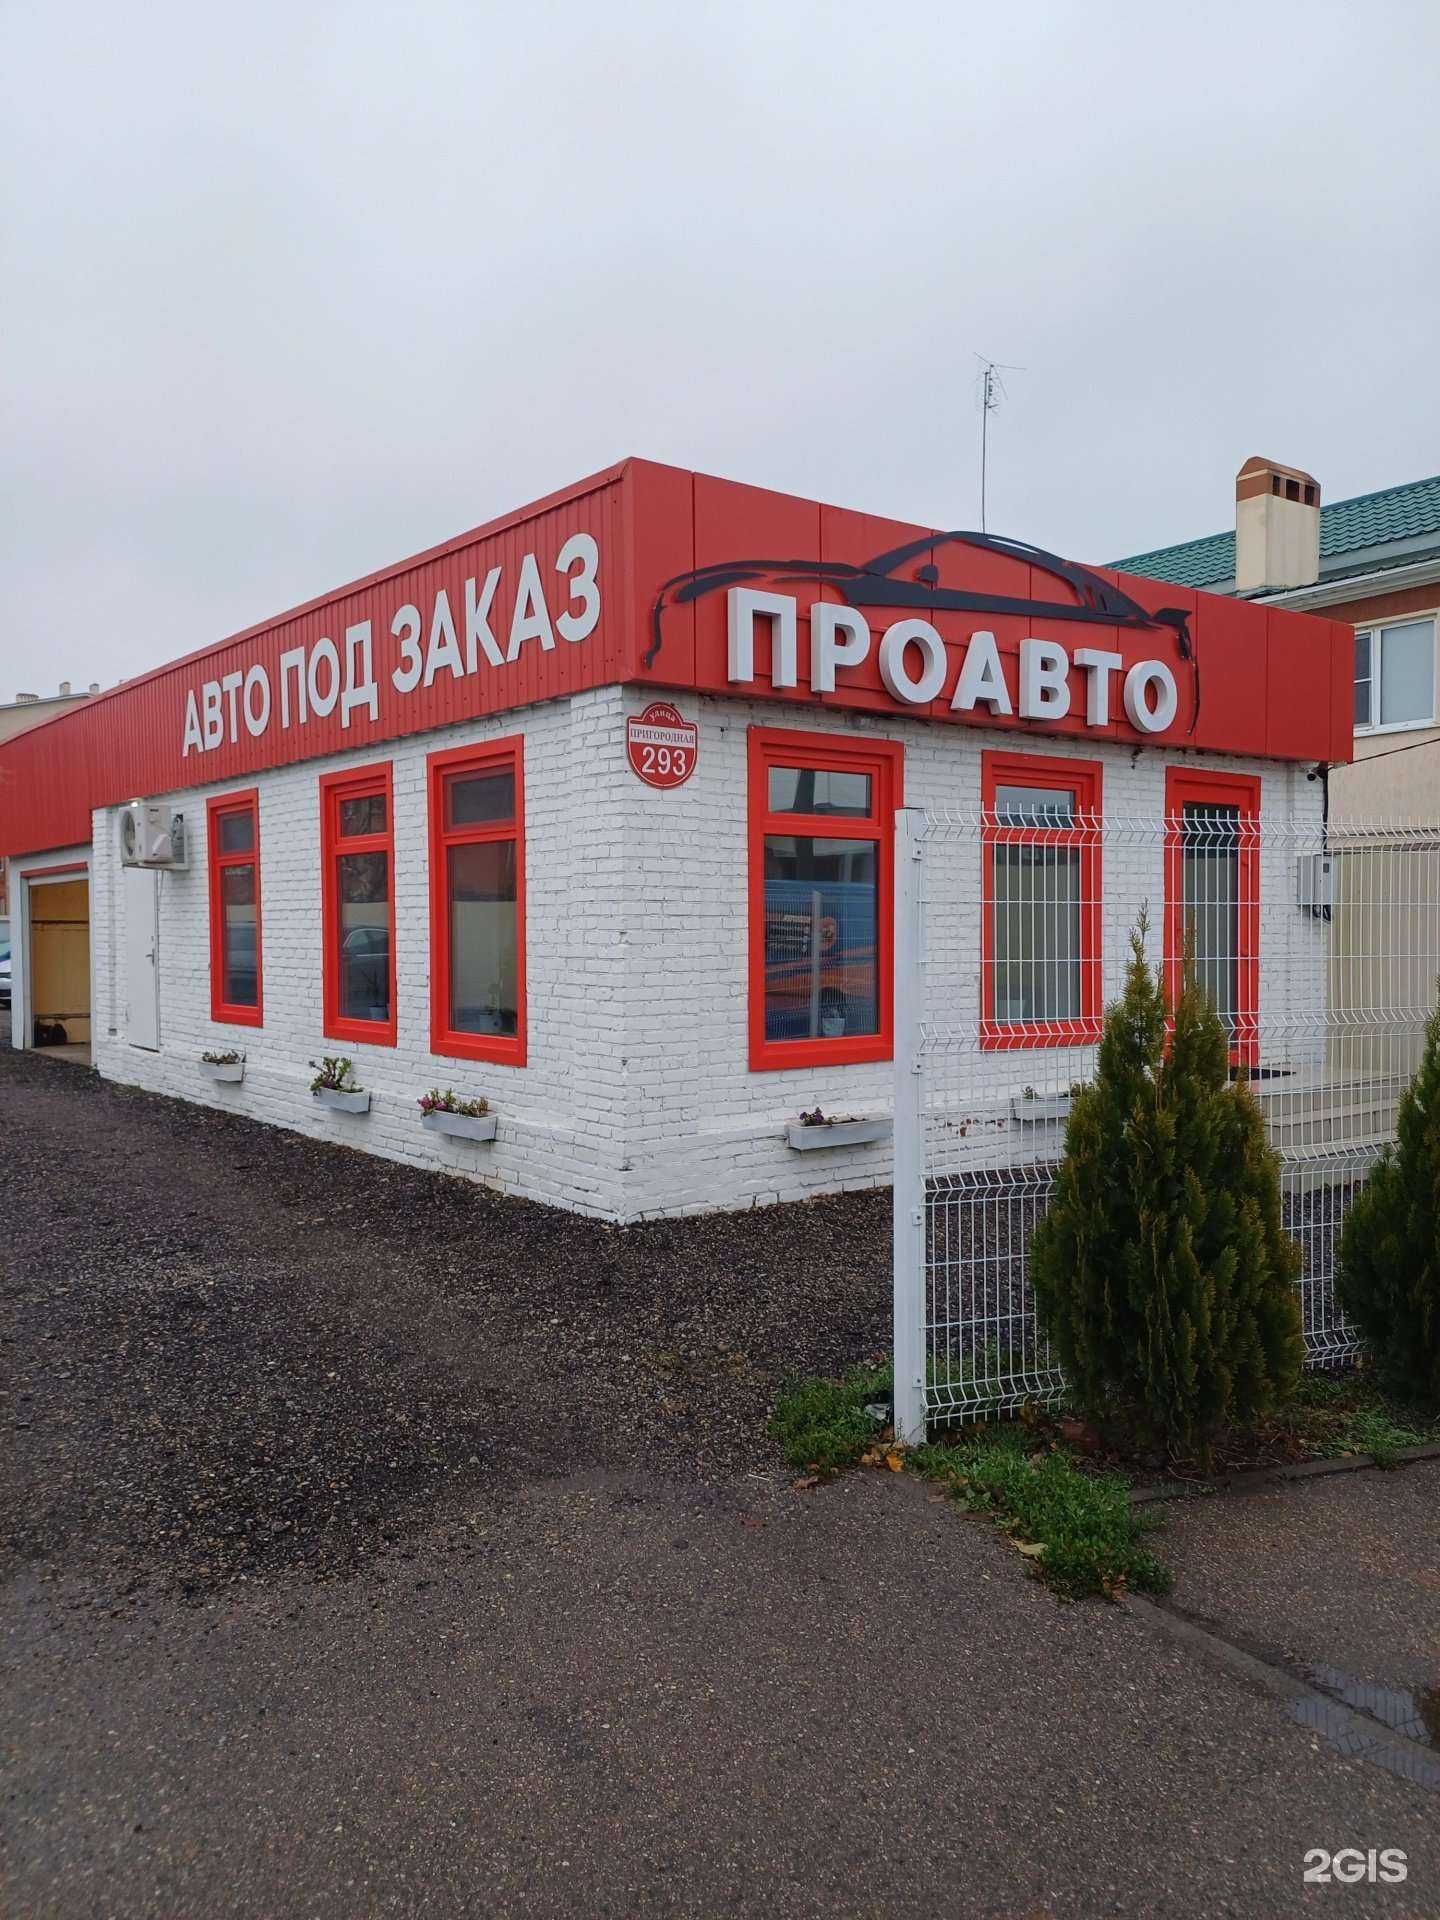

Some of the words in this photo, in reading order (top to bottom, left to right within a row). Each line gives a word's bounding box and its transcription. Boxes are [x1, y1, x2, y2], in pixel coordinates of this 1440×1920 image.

[182, 664, 271, 757] АВТО
[280, 619, 379, 729] ПОД
[391, 533, 601, 693] ЗАКАЗ
[727, 586, 1178, 734] ПРОАВТО
[630, 728, 694, 744] ПРИГОРОДНАЯ
[641, 746, 686, 776] 293
